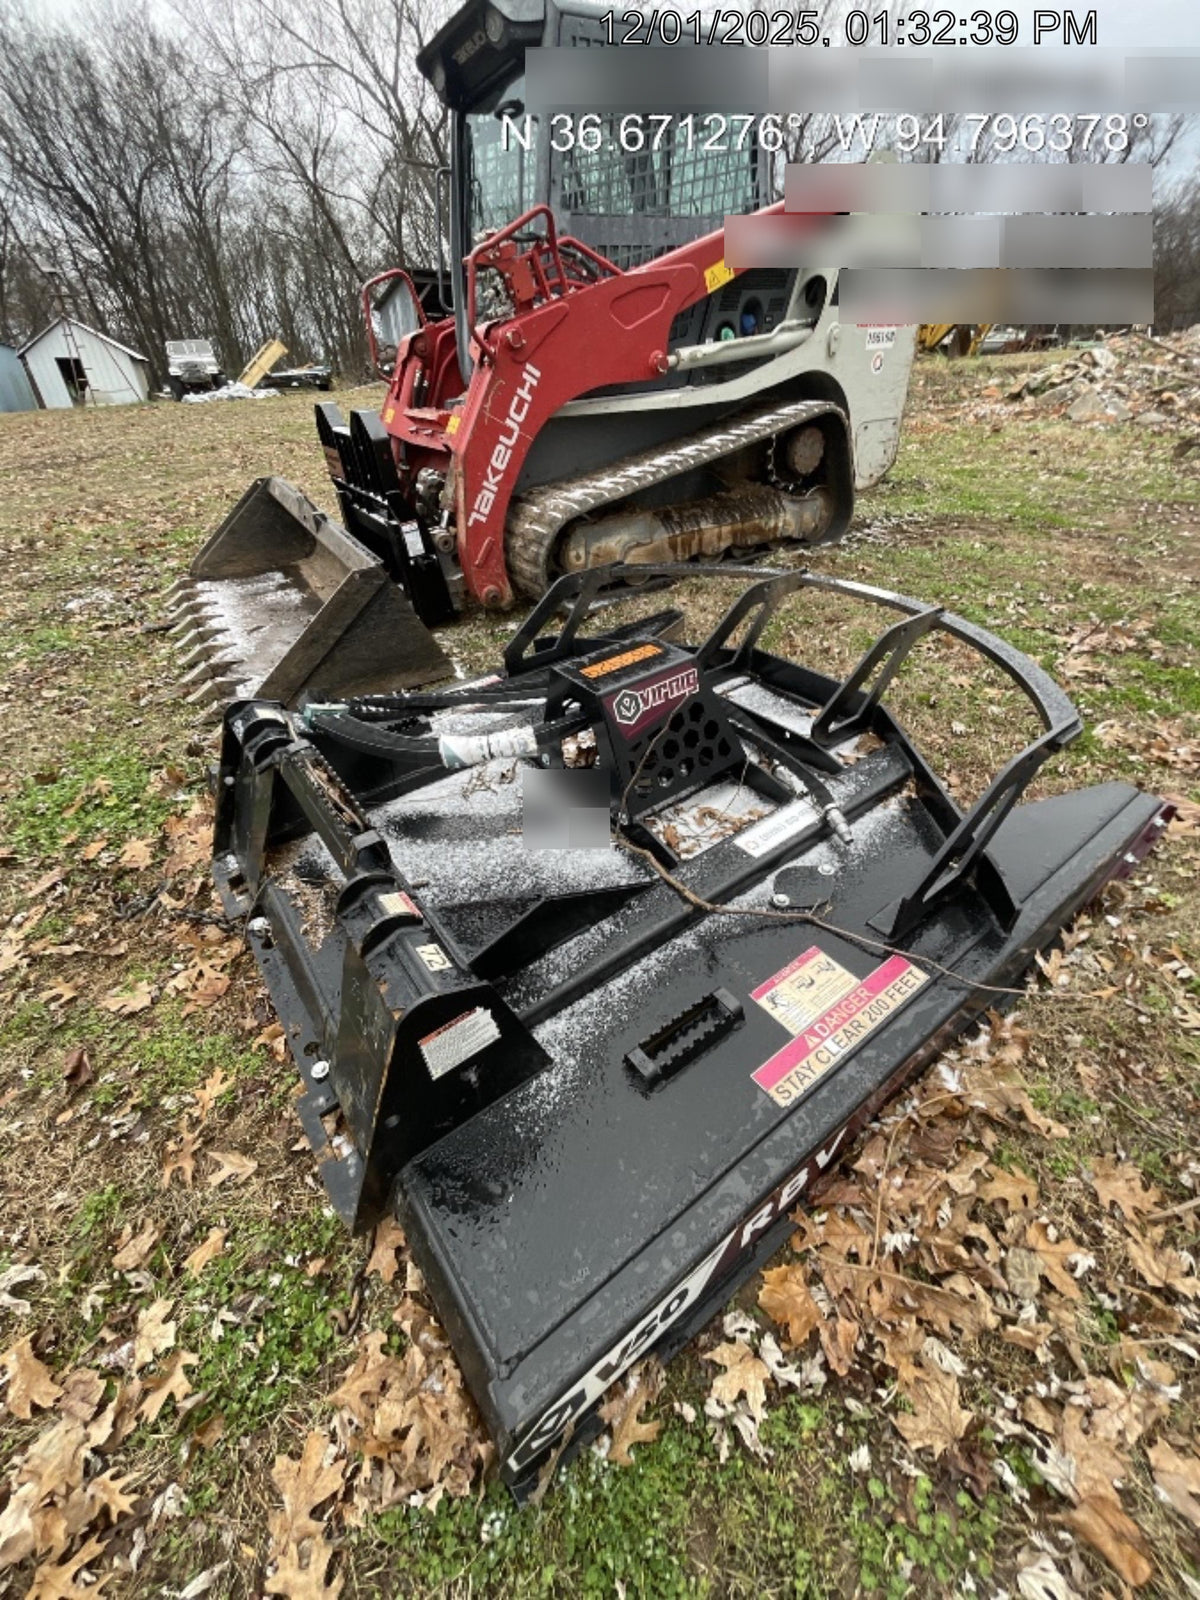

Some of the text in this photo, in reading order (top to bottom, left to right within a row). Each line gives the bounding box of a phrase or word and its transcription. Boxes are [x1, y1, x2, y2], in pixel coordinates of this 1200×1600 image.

[467, 363, 542, 527] TAKEUCHI
[774, 1060, 818, 1101] STAY
[815, 1019, 866, 1058] CLEAR
[862, 1002, 891, 1023] 200
[884, 969, 923, 1002] FEET
[813, 987, 874, 1037] DANGER
[595, 1287, 689, 1382] V50
